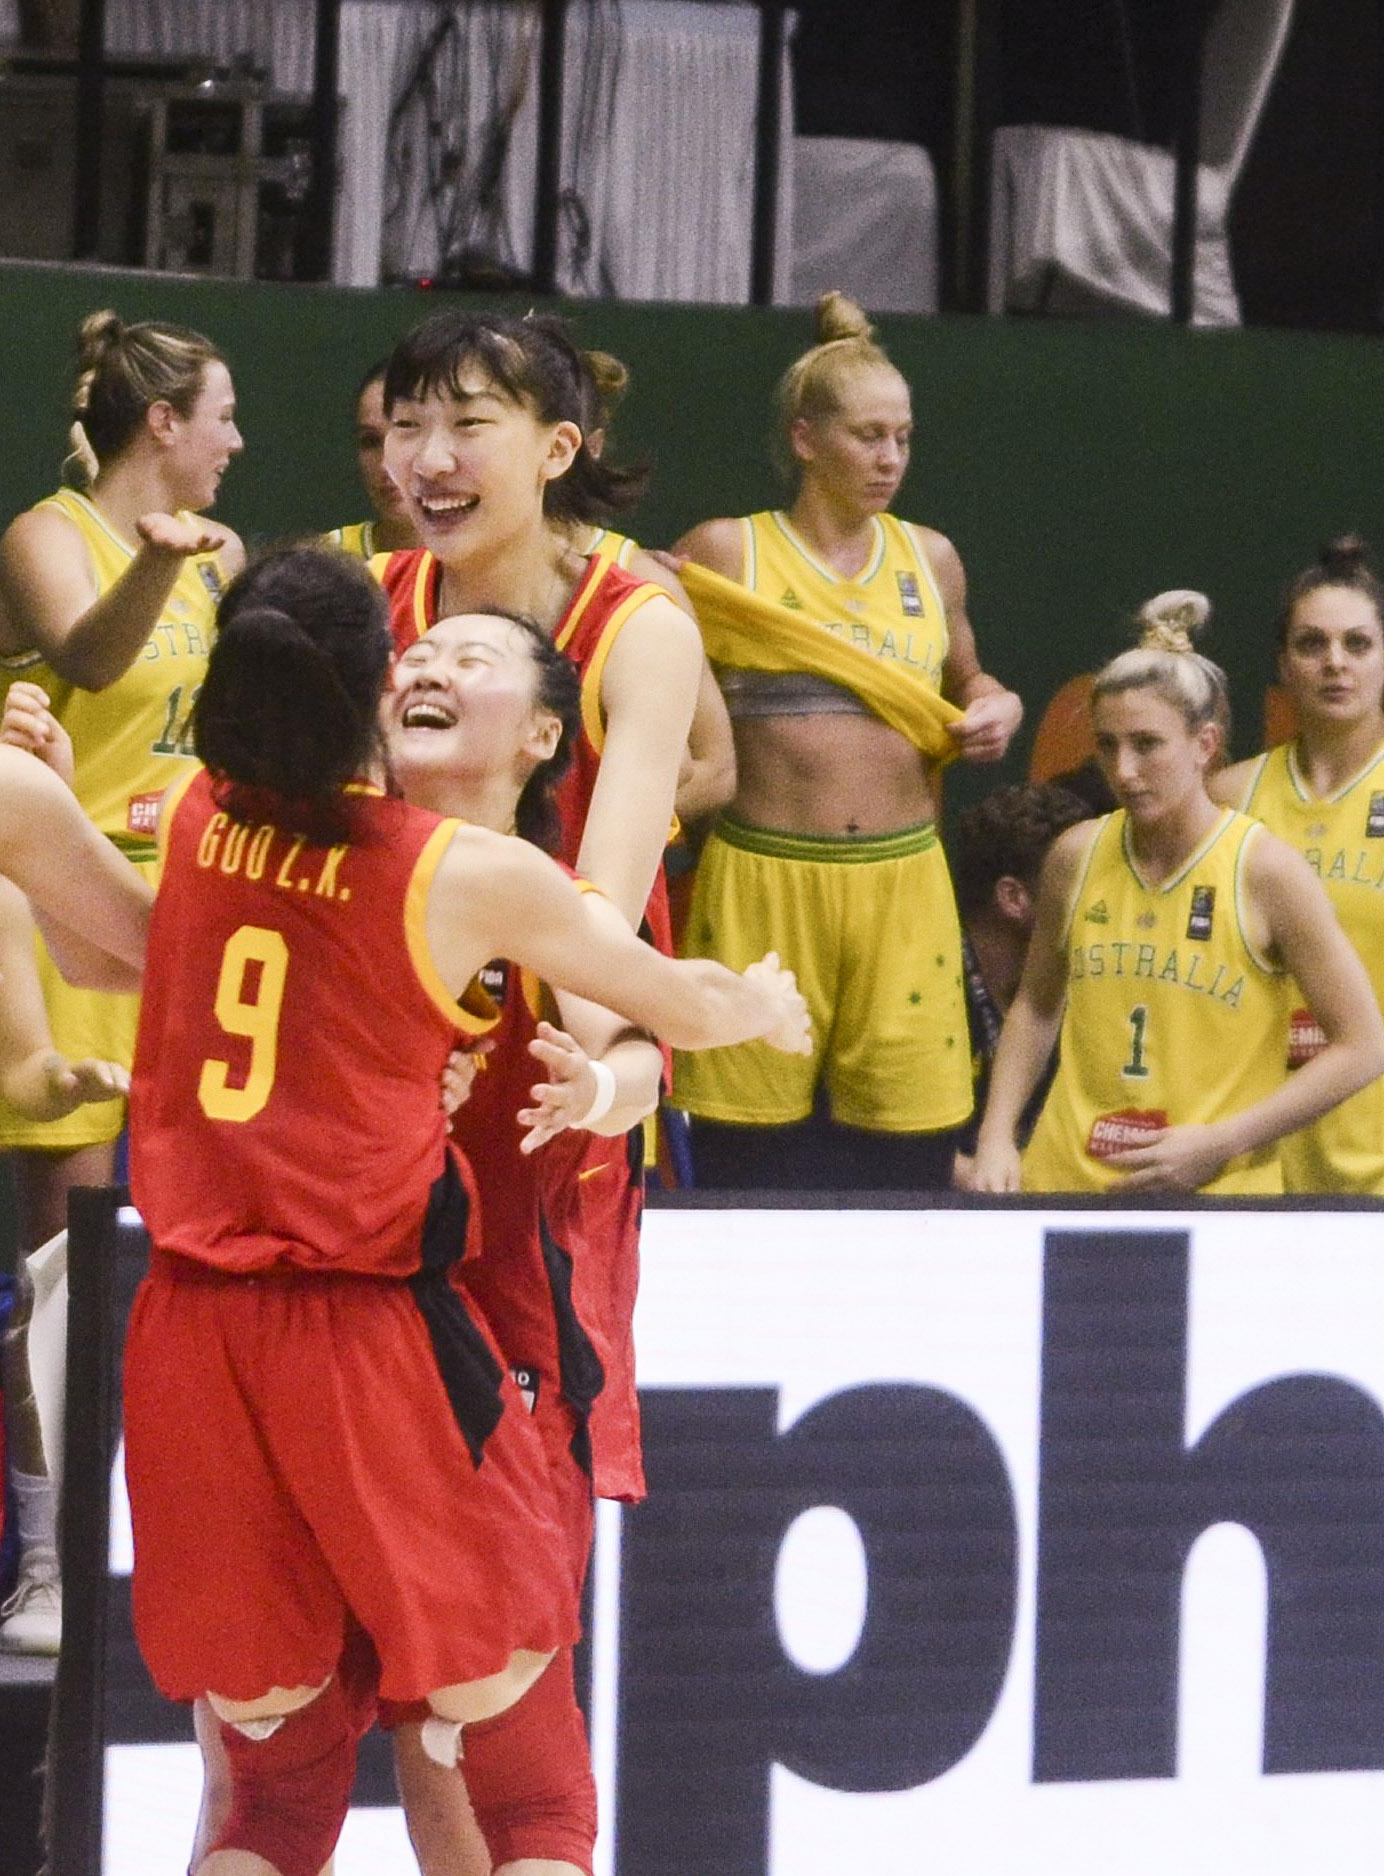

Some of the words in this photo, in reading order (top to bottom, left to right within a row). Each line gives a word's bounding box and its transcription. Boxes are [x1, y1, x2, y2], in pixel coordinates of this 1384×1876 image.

[197, 811, 275, 880] GUO
[197, 924, 289, 1123] 9
[1120, 1004, 1152, 1080] 1
